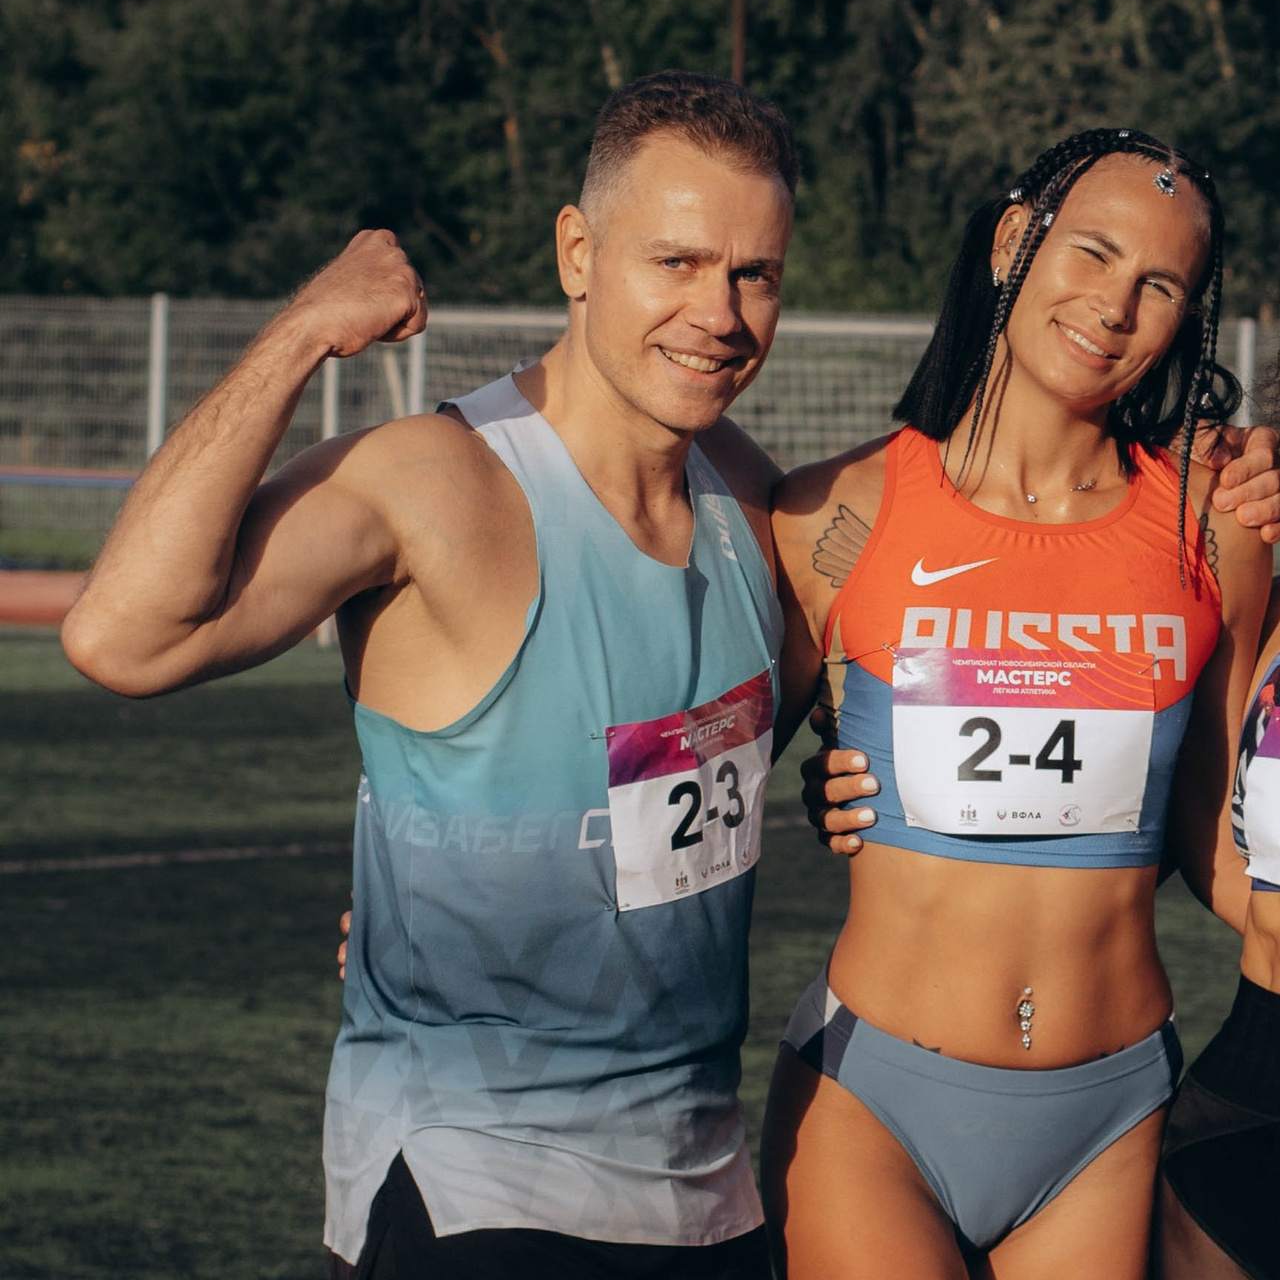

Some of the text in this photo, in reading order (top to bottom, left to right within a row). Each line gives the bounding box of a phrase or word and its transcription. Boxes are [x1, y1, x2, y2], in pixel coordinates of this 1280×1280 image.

[952, 659, 1096, 669] ЧЕМПИОНАТ НОВОСИБИРСКОЙ ОБЛАСТИ
[976, 669, 1072, 687] МАСТЕРС
[992, 687, 1057, 696] ЛЕГКАЯ АТЛЕТИКА
[680, 714, 736, 751] МАСТЕРС
[957, 716, 1083, 784] 2-4
[667, 760, 746, 852] 2-3
